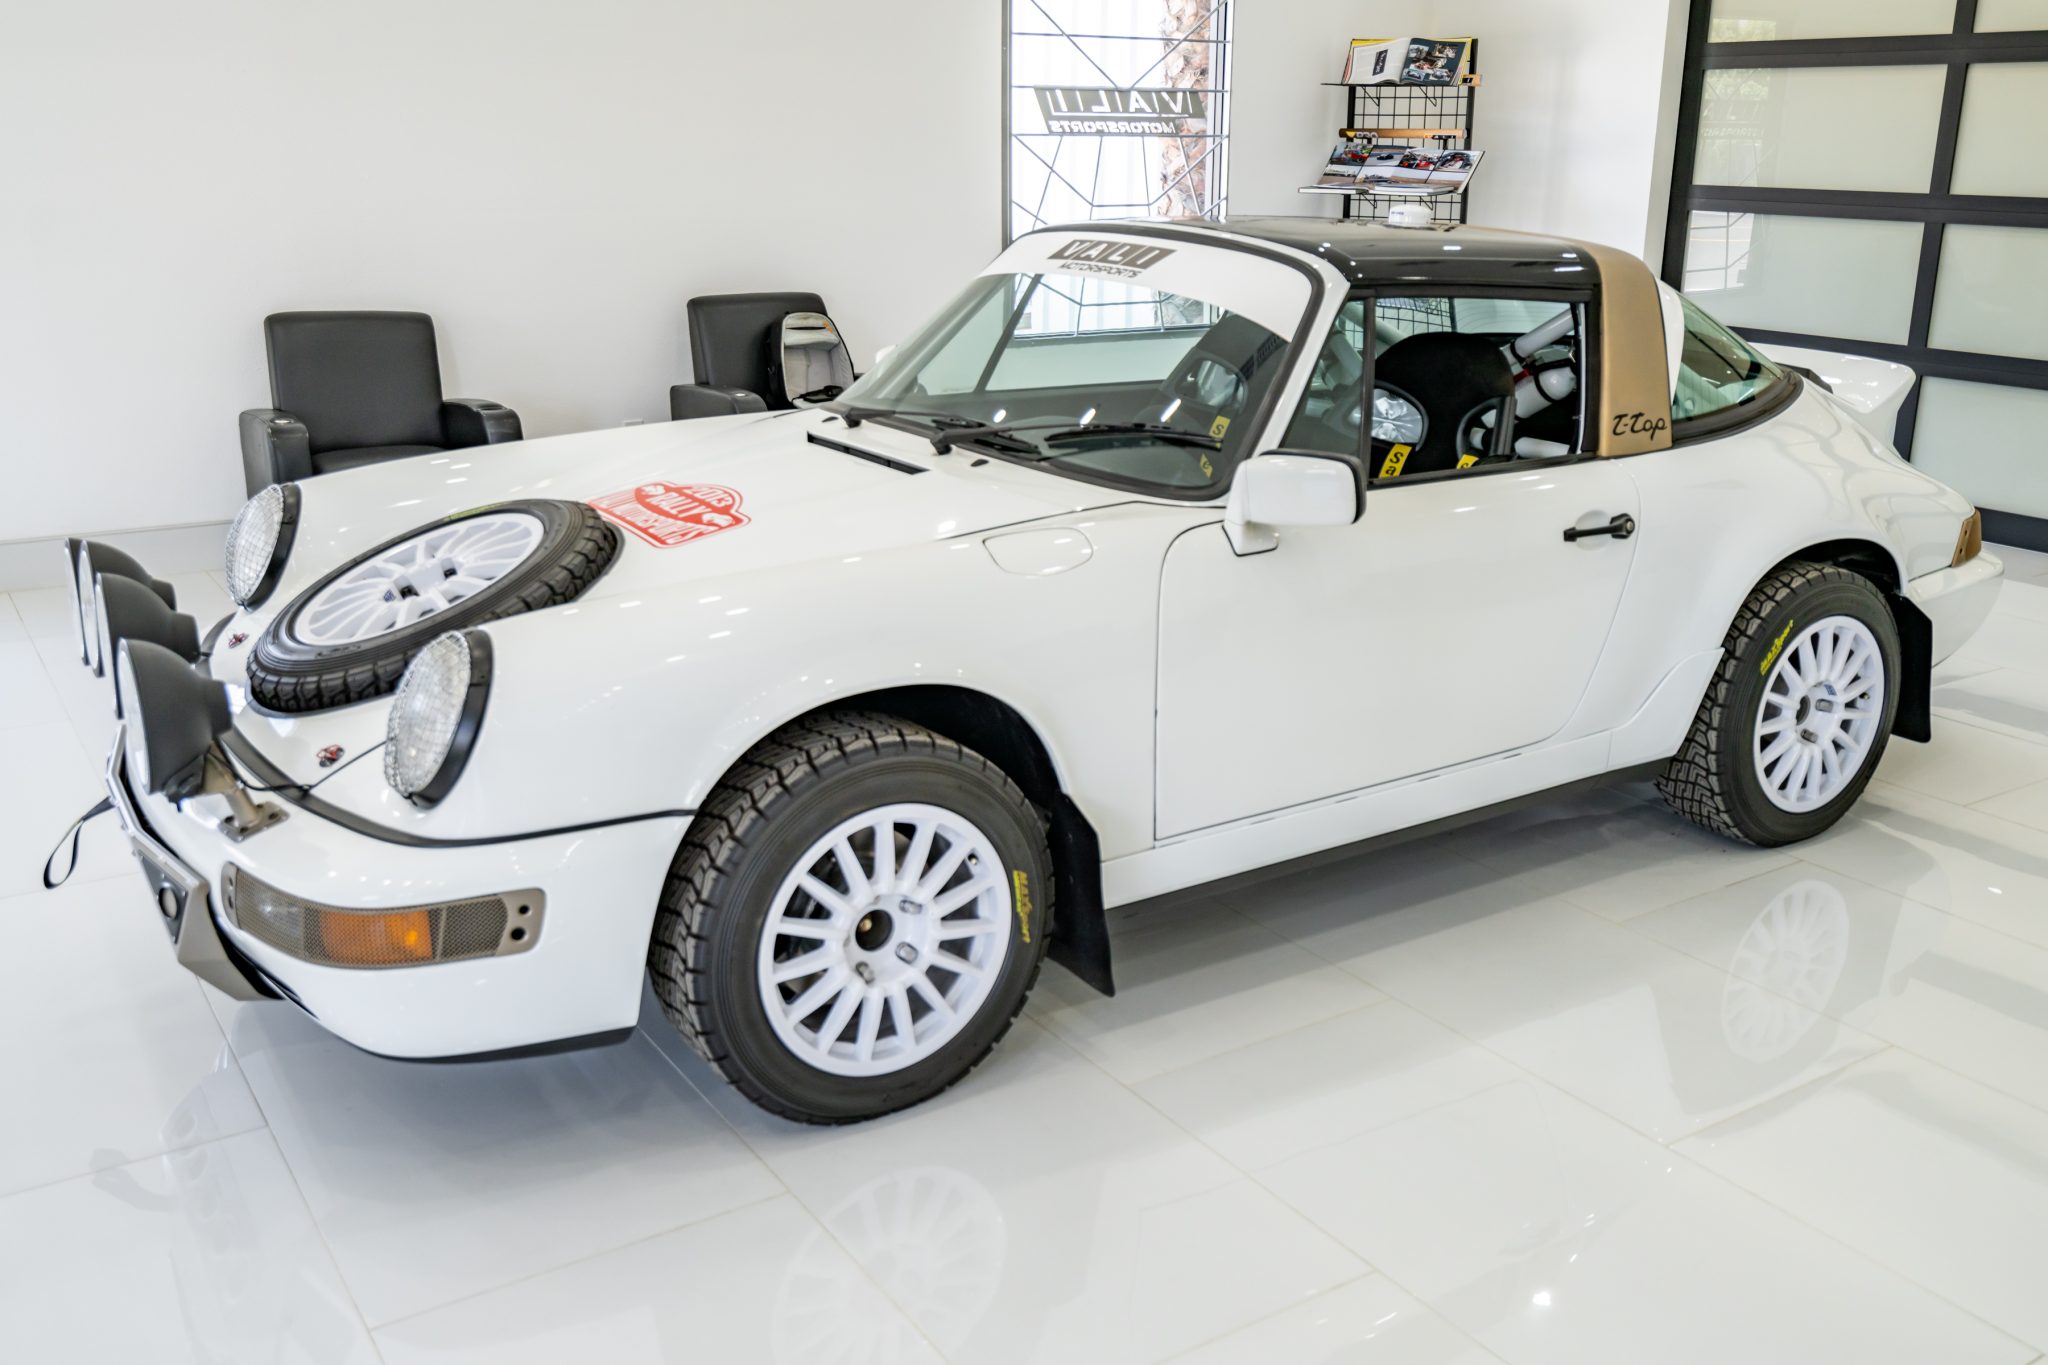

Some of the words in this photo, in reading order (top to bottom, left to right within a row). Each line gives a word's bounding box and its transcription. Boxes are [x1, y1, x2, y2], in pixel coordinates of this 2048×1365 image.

[1062, 240, 1162, 266] VALI
[1058, 261, 1142, 278] MOTORSPORTS
[645, 491, 712, 518] RALLY
